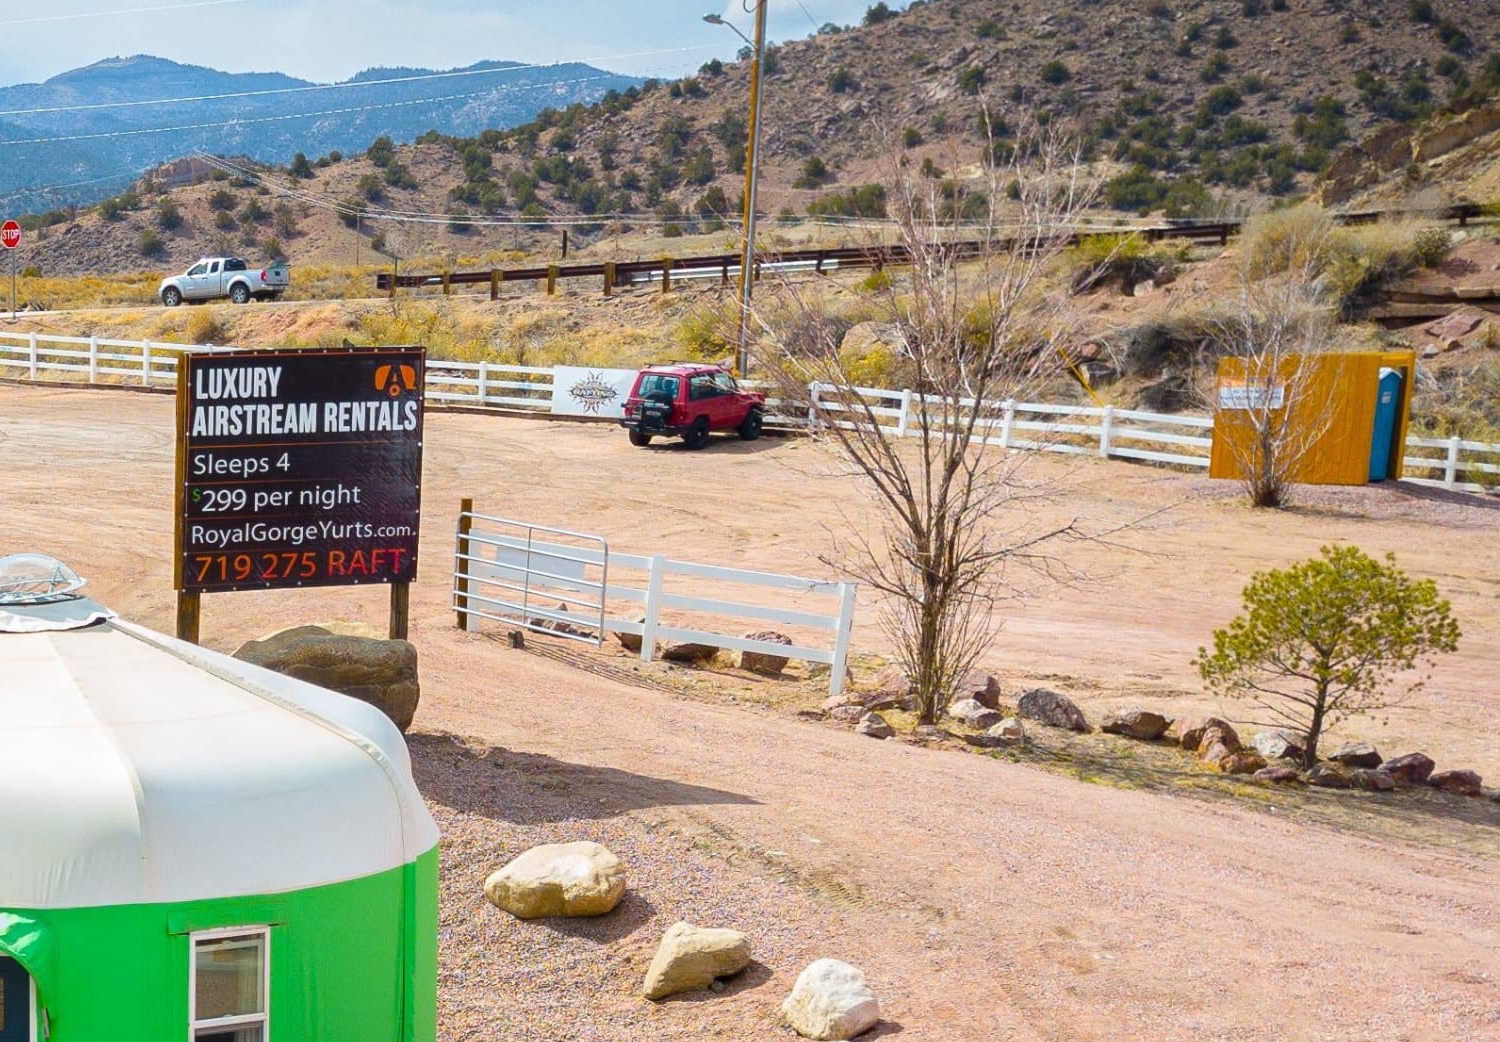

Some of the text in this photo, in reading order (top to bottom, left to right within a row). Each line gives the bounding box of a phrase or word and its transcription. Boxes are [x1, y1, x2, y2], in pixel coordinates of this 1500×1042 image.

[195, 366, 282, 399] LUXURY
[192, 401, 417, 437] AIRSTREAM RENTALS
[193, 453, 290, 477] Sleeps 4
[192, 484, 361, 512] $299 per night
[191, 521, 411, 548] RoyalGorgeYurts.com
[195, 548, 406, 581] 719 275 RAFT
